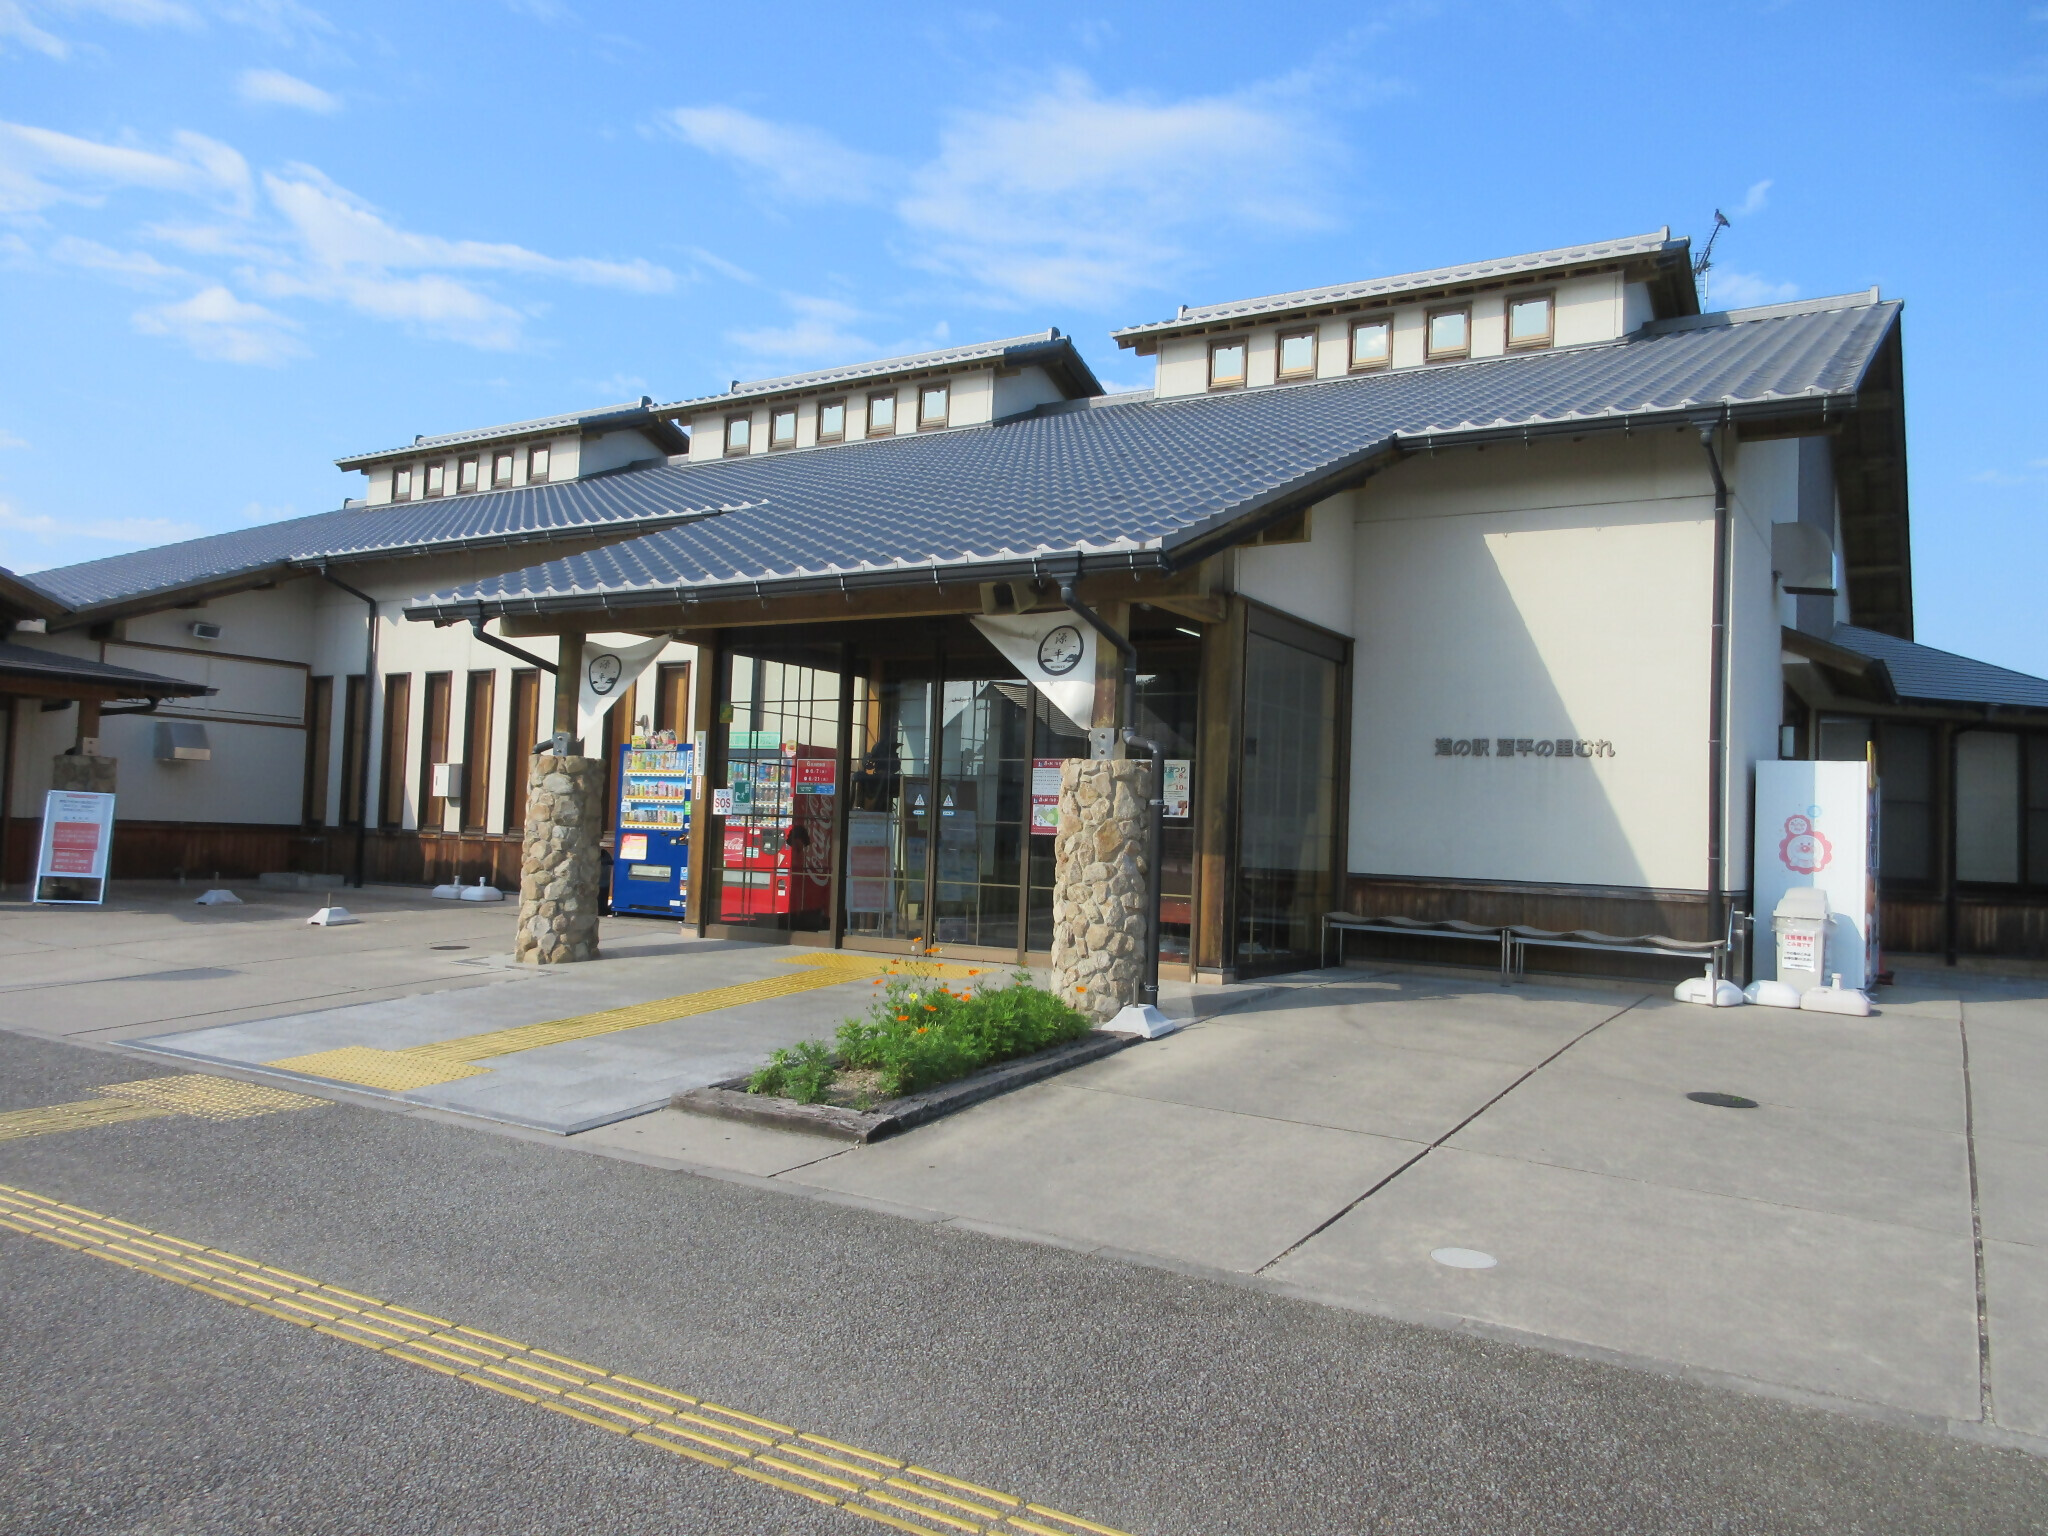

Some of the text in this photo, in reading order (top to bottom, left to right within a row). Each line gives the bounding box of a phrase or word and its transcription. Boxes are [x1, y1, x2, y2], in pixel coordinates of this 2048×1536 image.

[1435, 739, 1616, 758] 道の駅 源平の里むれ
[715, 798, 731, 808] SOS
